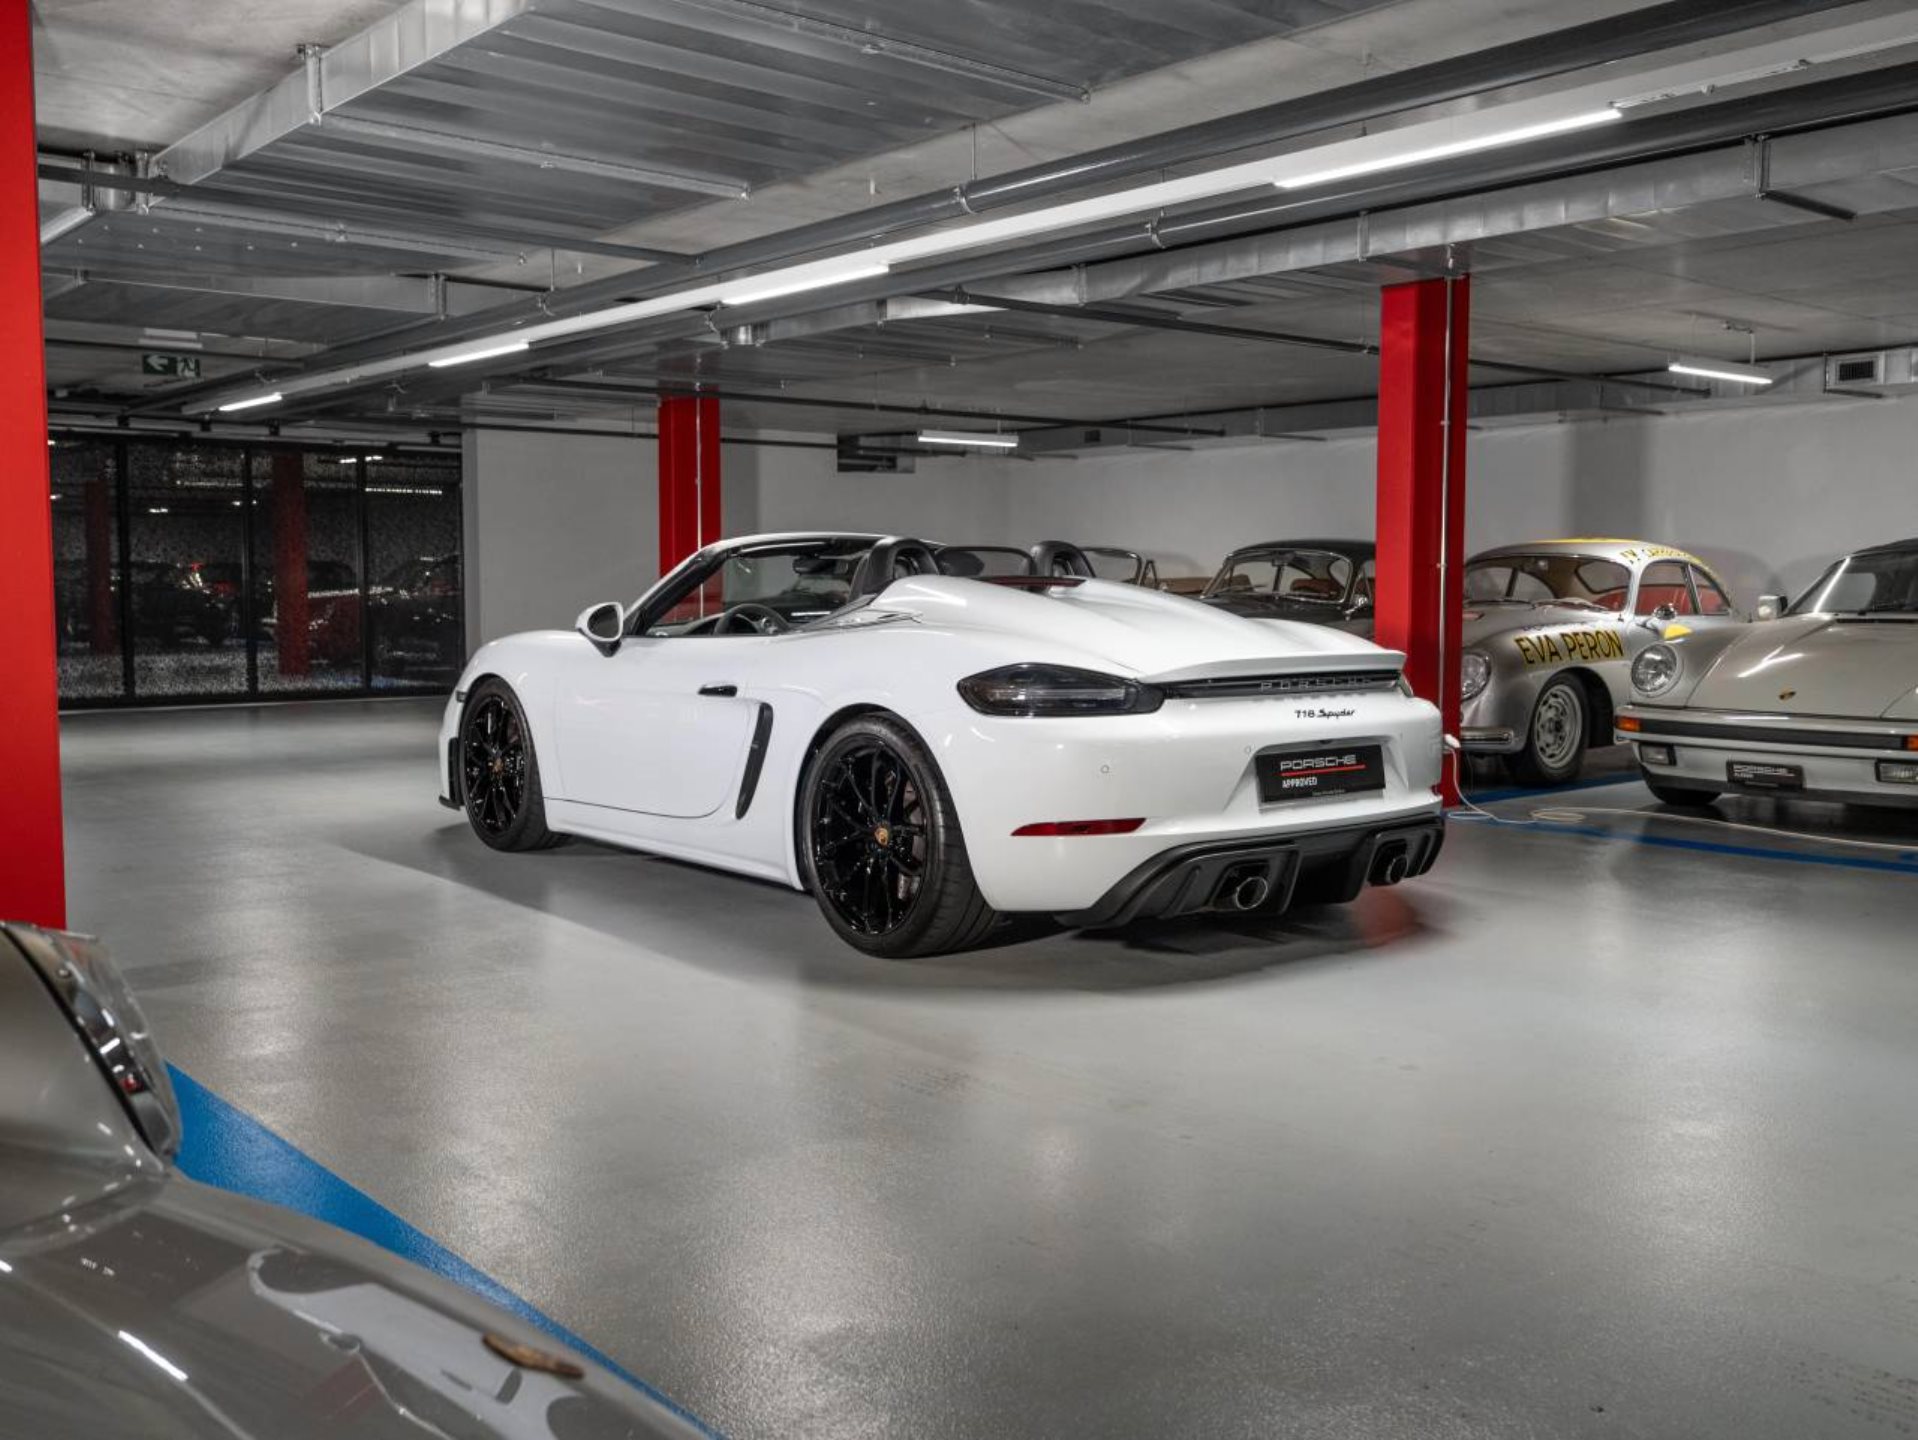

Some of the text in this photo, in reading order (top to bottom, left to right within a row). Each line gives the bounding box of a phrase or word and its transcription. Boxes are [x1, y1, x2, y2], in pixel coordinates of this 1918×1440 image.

[1514, 630, 1624, 664] EVA PERON
[1295, 708, 1355, 720] 718 Spyder
[1280, 754, 1357, 771] PORSCHE
[1282, 776, 1318, 789] APPROVED
